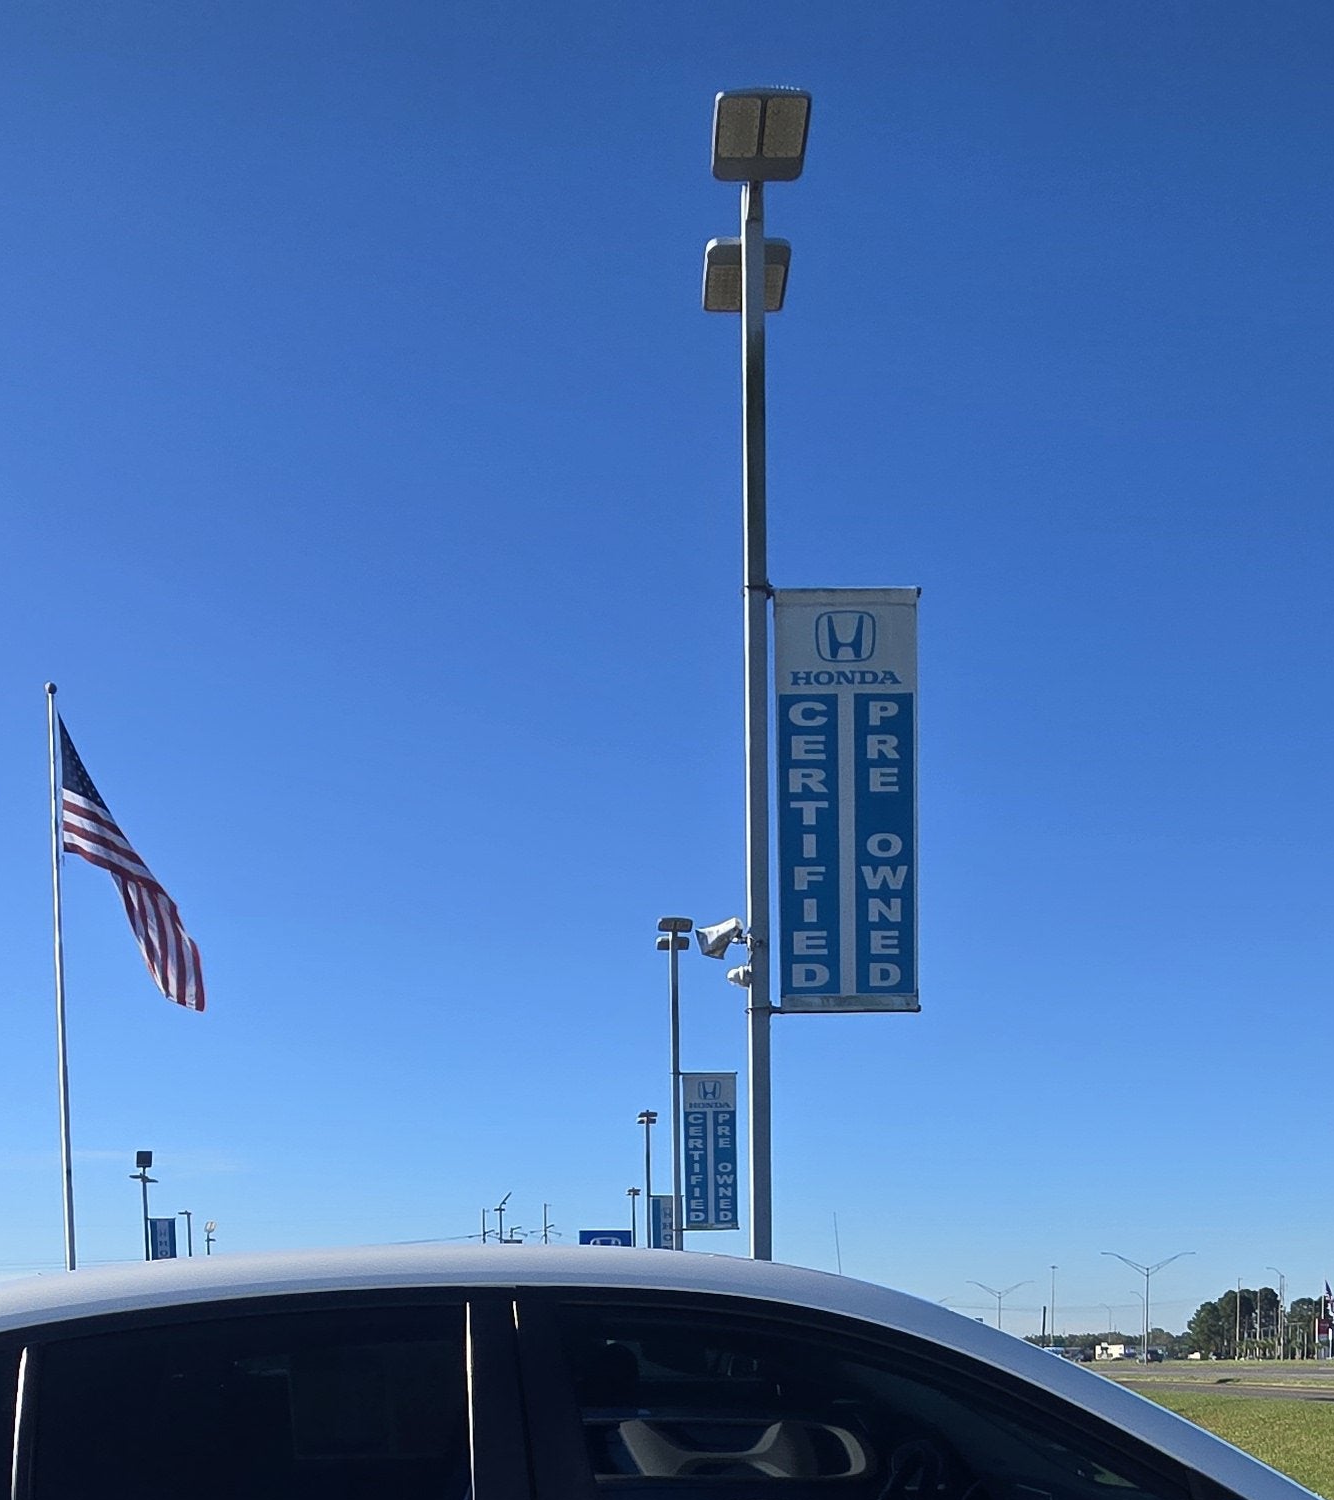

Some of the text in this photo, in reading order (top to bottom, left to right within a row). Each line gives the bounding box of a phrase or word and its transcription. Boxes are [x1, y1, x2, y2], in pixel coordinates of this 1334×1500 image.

[790, 670, 902, 686] HONDA
[788, 701, 830, 988] CERTIFIED
[861, 701, 908, 987] PRE OWNED
[687, 1113, 705, 1221] CERTIFIED
[716, 1113, 735, 1221] PRE OWNED
